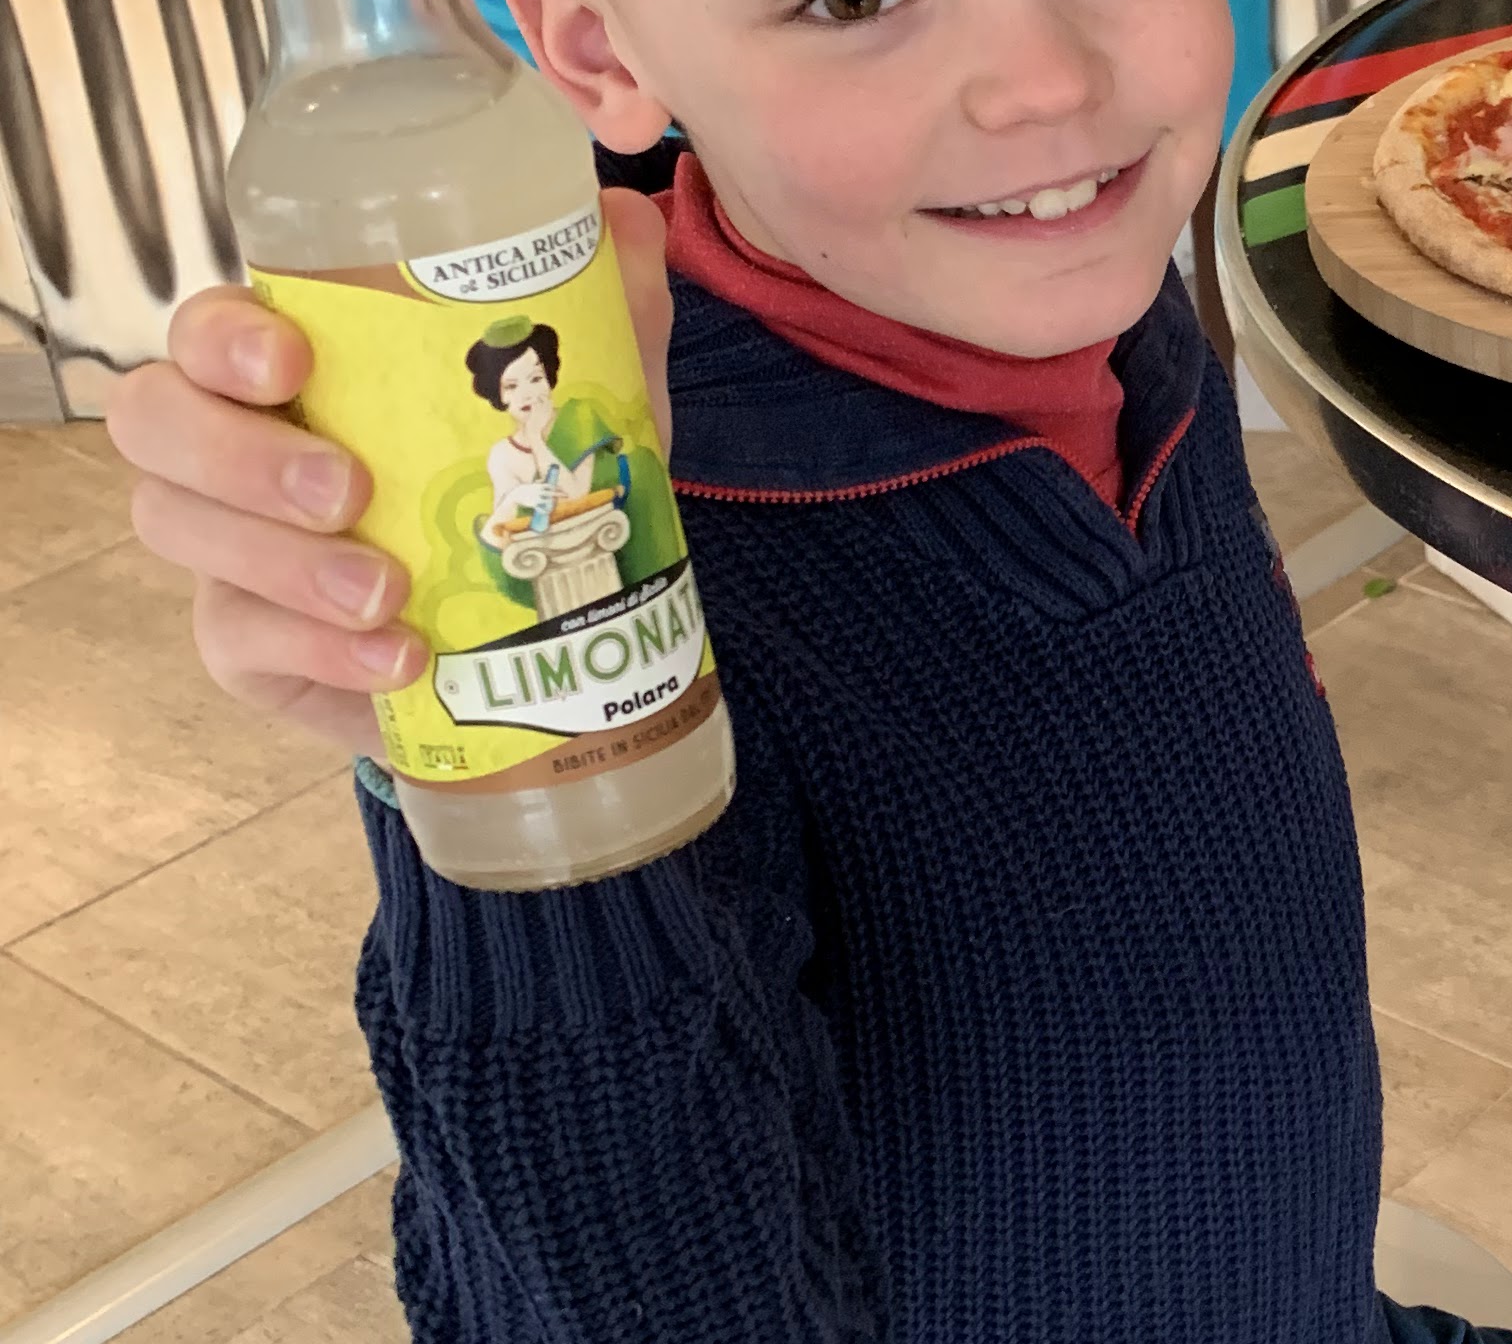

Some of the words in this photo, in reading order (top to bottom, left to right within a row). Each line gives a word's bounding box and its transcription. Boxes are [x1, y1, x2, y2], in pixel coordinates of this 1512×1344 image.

[432, 246, 525, 283] ANTICA
[487, 243, 586, 291] SICILIANA
[603, 675, 679, 722] Polara
[552, 749, 606, 774] BIBITE
[611, 741, 628, 757] IN
